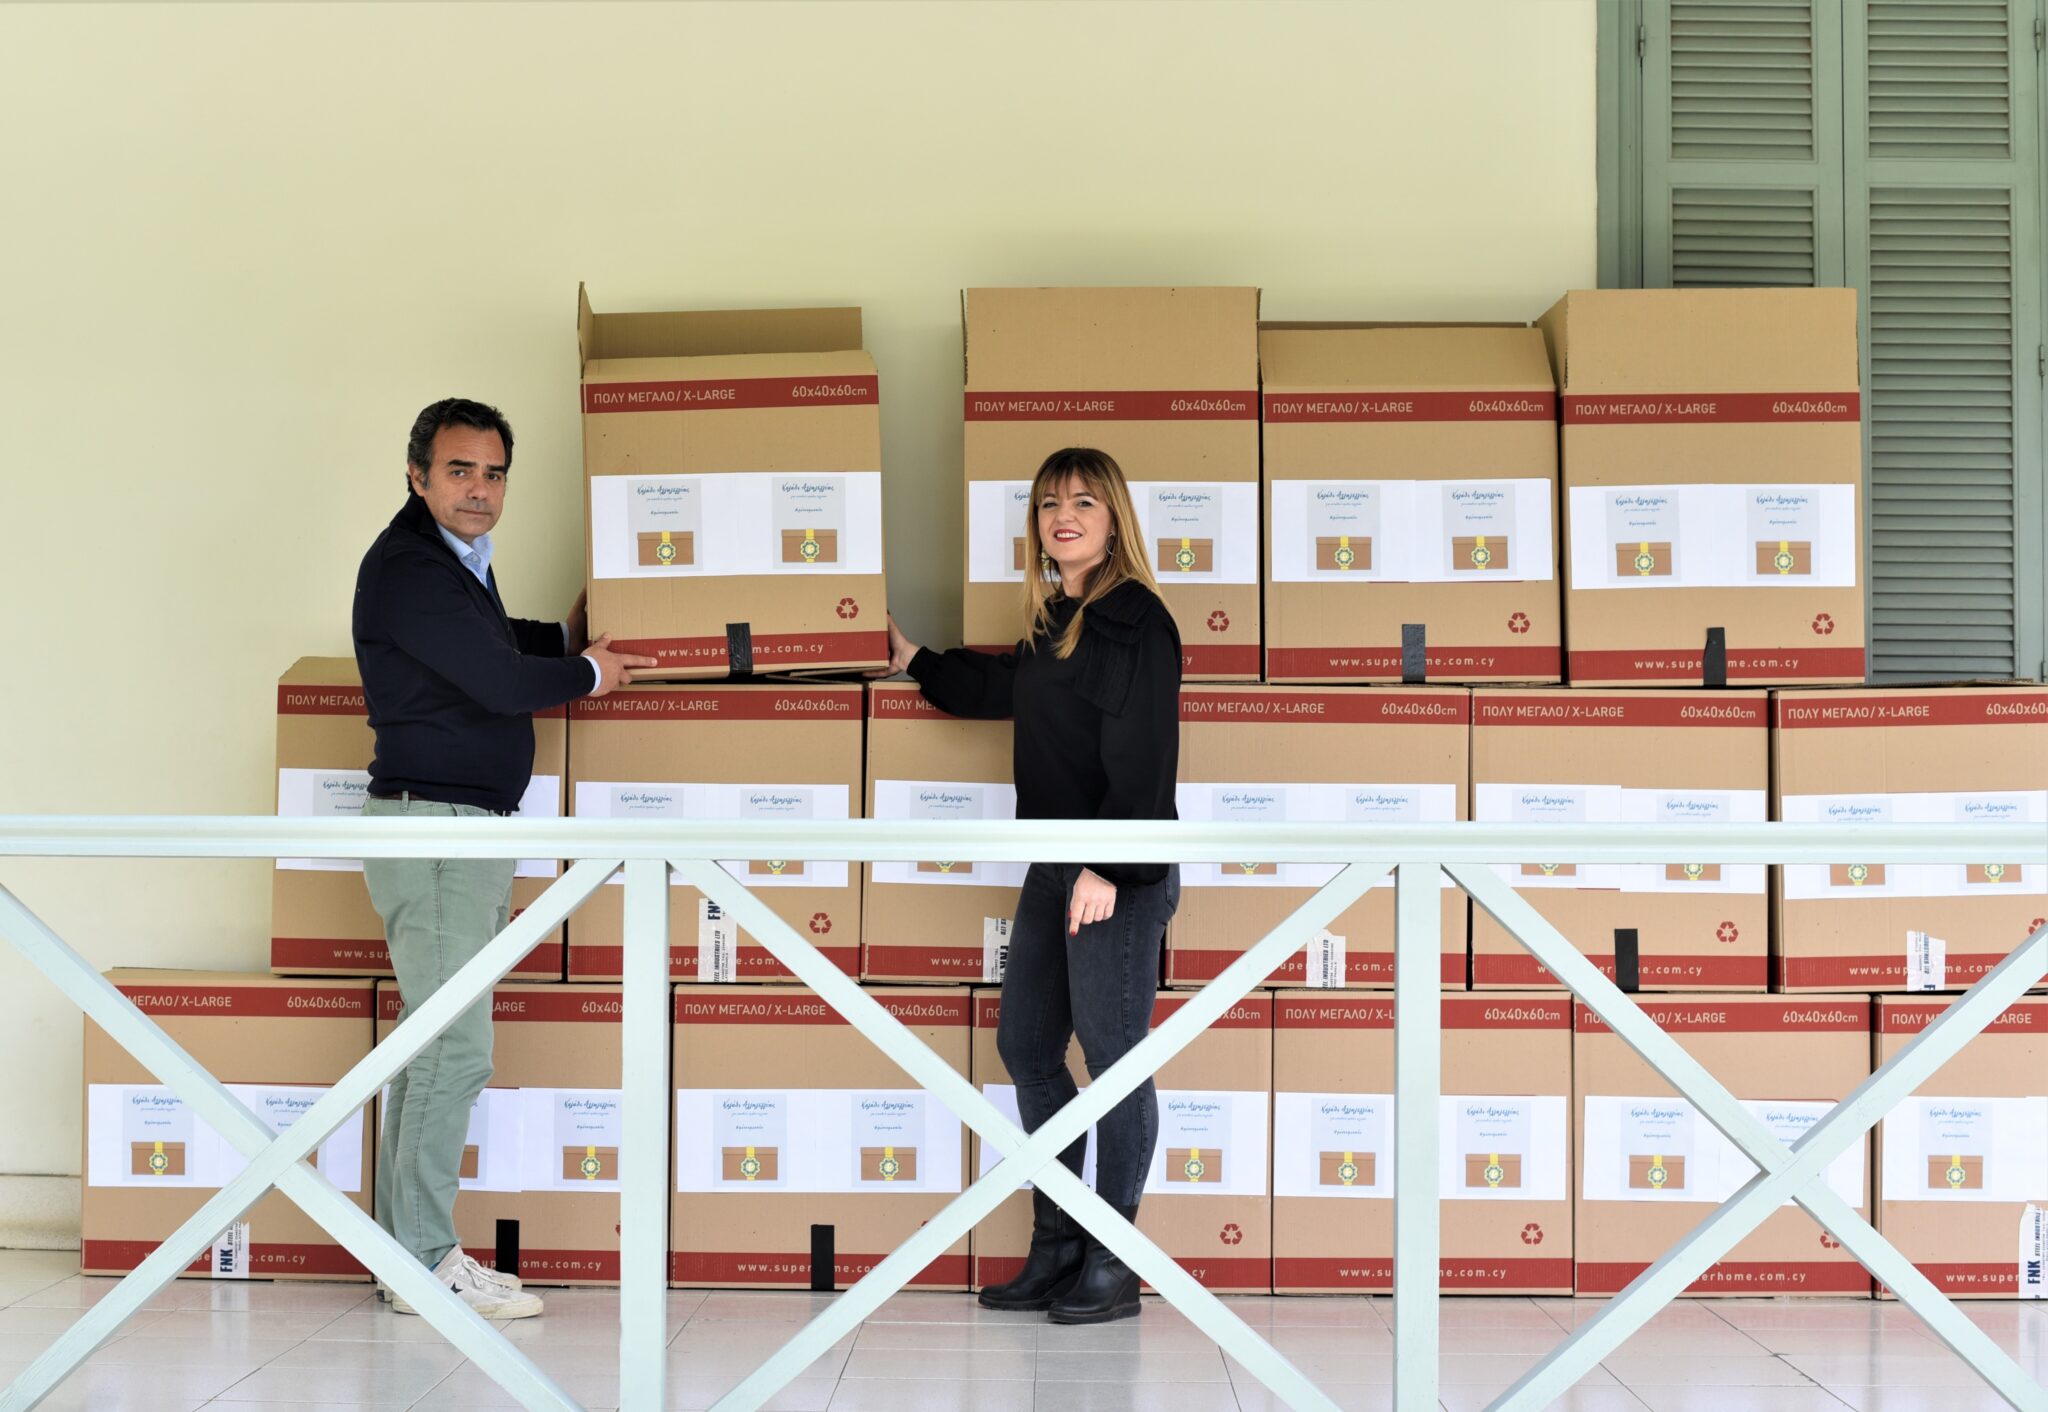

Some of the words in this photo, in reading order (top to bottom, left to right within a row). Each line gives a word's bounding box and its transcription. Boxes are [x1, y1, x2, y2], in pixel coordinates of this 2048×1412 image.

[595, 393, 625, 404] ΠΟΛΥ
[684, 389, 736, 401] X-LARGE
[793, 385, 868, 398] 60x40x60cm
[975, 402, 1006, 412] ΠΟΛΥ
[1064, 401, 1115, 412] X-LARGE
[1171, 400, 1246, 412] 60x40x60cm
[1273, 403, 1304, 414] ΠΟΛΥ
[1362, 402, 1413, 413] X-LARGE
[1470, 401, 1544, 412] 60x40x60cm
[1576, 405, 1607, 416] ΠΟΛΥ
[1666, 404, 1716, 415] X-LARGE
[1773, 401, 1847, 414] 60x40x60cm
[658, 644, 824, 657] www.supeme.com.cy
[1330, 657, 1494, 668] www.superme.com.cy
[1635, 658, 1798, 669] www.supeme.com.cy
[287, 695, 317, 706] ΠΟΛΥ
[320, 696, 365, 706] ΜΕΓΑΛΟ
[580, 701, 610, 711] ΠΟΛΥ
[668, 701, 719, 711] X-LARGE
[775, 700, 850, 711] 60x40x60cm
[882, 700, 912, 710] ΠΟΛΥ
[1184, 702, 1214, 713] ΠΟΛΥ
[1274, 703, 1325, 714] X-LARGE
[1382, 703, 1457, 716] 60x40x60cm
[1483, 706, 1514, 717] ΠΟΛΥ
[1573, 707, 1624, 718] X-LARGE
[1681, 706, 1756, 719] 60x40x60cm
[1789, 709, 1819, 720] ΠΟΛΥ
[1879, 706, 1930, 718] X-LARGE
[1986, 703, 2048, 716] 60x40x60
[182, 997, 232, 1007] X-LARGE
[287, 997, 361, 1009] 60x40x60cm
[387, 1001, 402, 1011] ΠΟ
[492, 1002, 526, 1013] ARGE
[686, 1004, 716, 1015] ΠΟΛΥ
[775, 1004, 826, 1015] X-LARGE
[986, 1008, 1000, 1018] ΠΟ
[1222, 1008, 1261, 1019] x60cm
[1286, 1009, 1317, 1020] ΠΟΛΥ
[1485, 1008, 1561, 1020] 60x40x60cm
[1585, 1013, 1603, 1023] ΠΟ
[1675, 1013, 1726, 1024] X-LARGE
[1783, 1011, 1858, 1023] 60x40x60cm
[1892, 1014, 1923, 1025] ΠΟΛΥ
[220, 1249, 233, 1273] FNK
[2027, 1260, 2041, 1284] FNK
